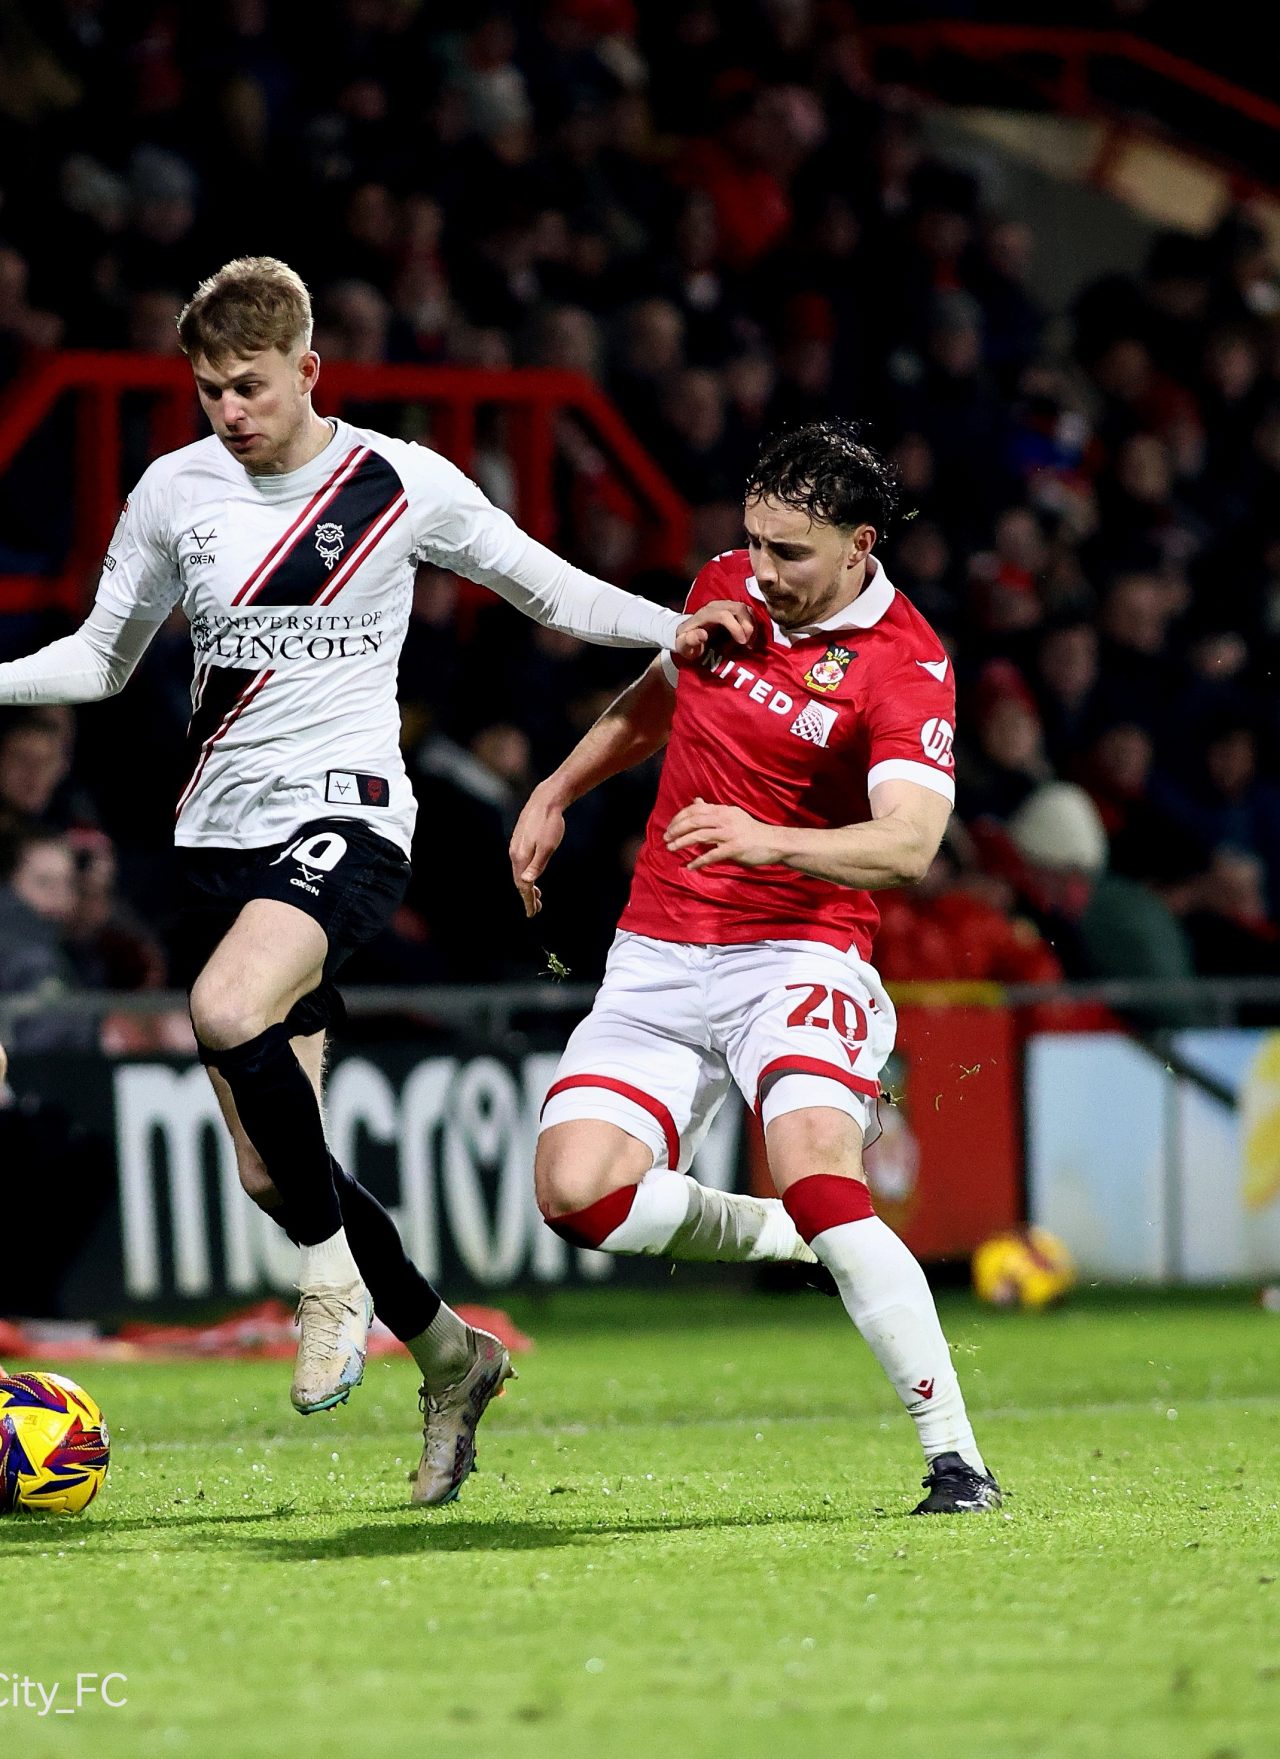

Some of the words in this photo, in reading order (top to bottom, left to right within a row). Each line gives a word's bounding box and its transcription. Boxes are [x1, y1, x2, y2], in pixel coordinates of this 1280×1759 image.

[189, 554, 216, 565] OXEN
[214, 615, 355, 630] UNIVERSITY
[361, 611, 382, 628] OF
[214, 631, 383, 661] LINCOLN
[701, 648, 794, 715] NITED
[269, 832, 347, 872] 0
[784, 983, 868, 1042] 20
[113, 1053, 617, 1298] mcro
